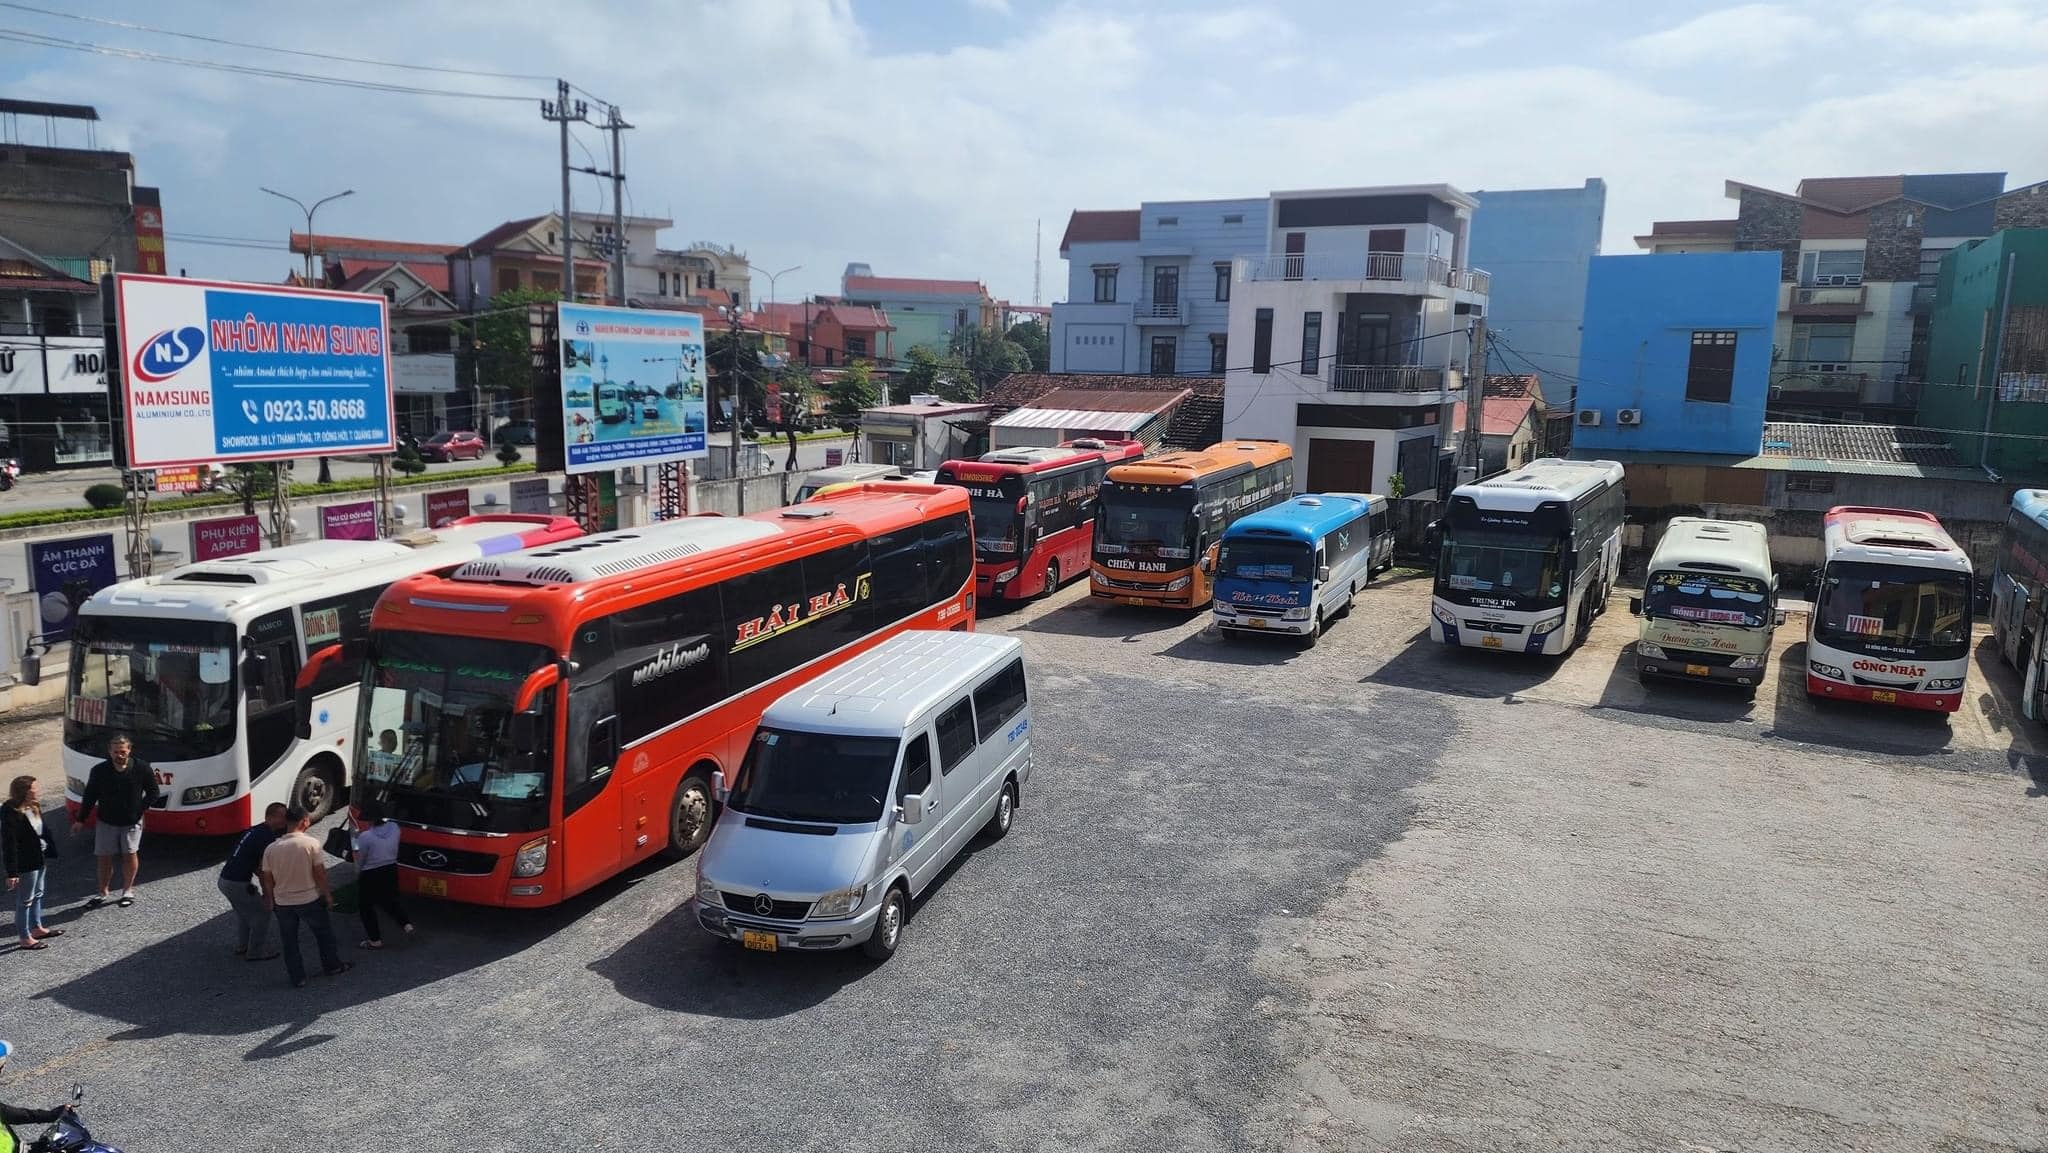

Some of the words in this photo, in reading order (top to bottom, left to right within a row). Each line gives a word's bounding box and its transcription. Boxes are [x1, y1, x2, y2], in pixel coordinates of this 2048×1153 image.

[210, 312, 278, 354] NHÔM
[283, 323, 326, 354] NAM
[329, 325, 381, 356] SUNG
[135, 391, 210, 406] NAMSUNG
[136, 410, 182, 419] ALUMINIUM
[263, 398, 366, 423] 0923.50.8668
[986, 488, 1004, 498] HÀ
[201, 528, 226, 541] PHỤ
[228, 523, 255, 538] KIỆN
[41, 550, 62, 563] ÂM
[64, 545, 105, 559] THANH
[210, 539, 247, 553] APPLE
[52, 562, 78, 575] CỰC
[79, 557, 98, 570] ĐÃ
[1107, 558, 1135, 570] CHIẾN
[1139, 561, 1166, 573] HẠNH
[1470, 597, 1498, 606] TRUNG
[1501, 599, 1516, 607] TÍN
[1850, 617, 1882, 635] VINH
[632, 643, 710, 687] mobihome
[1852, 658, 1888, 674] CÔNG
[1891, 662, 1926, 679] NHẬT
